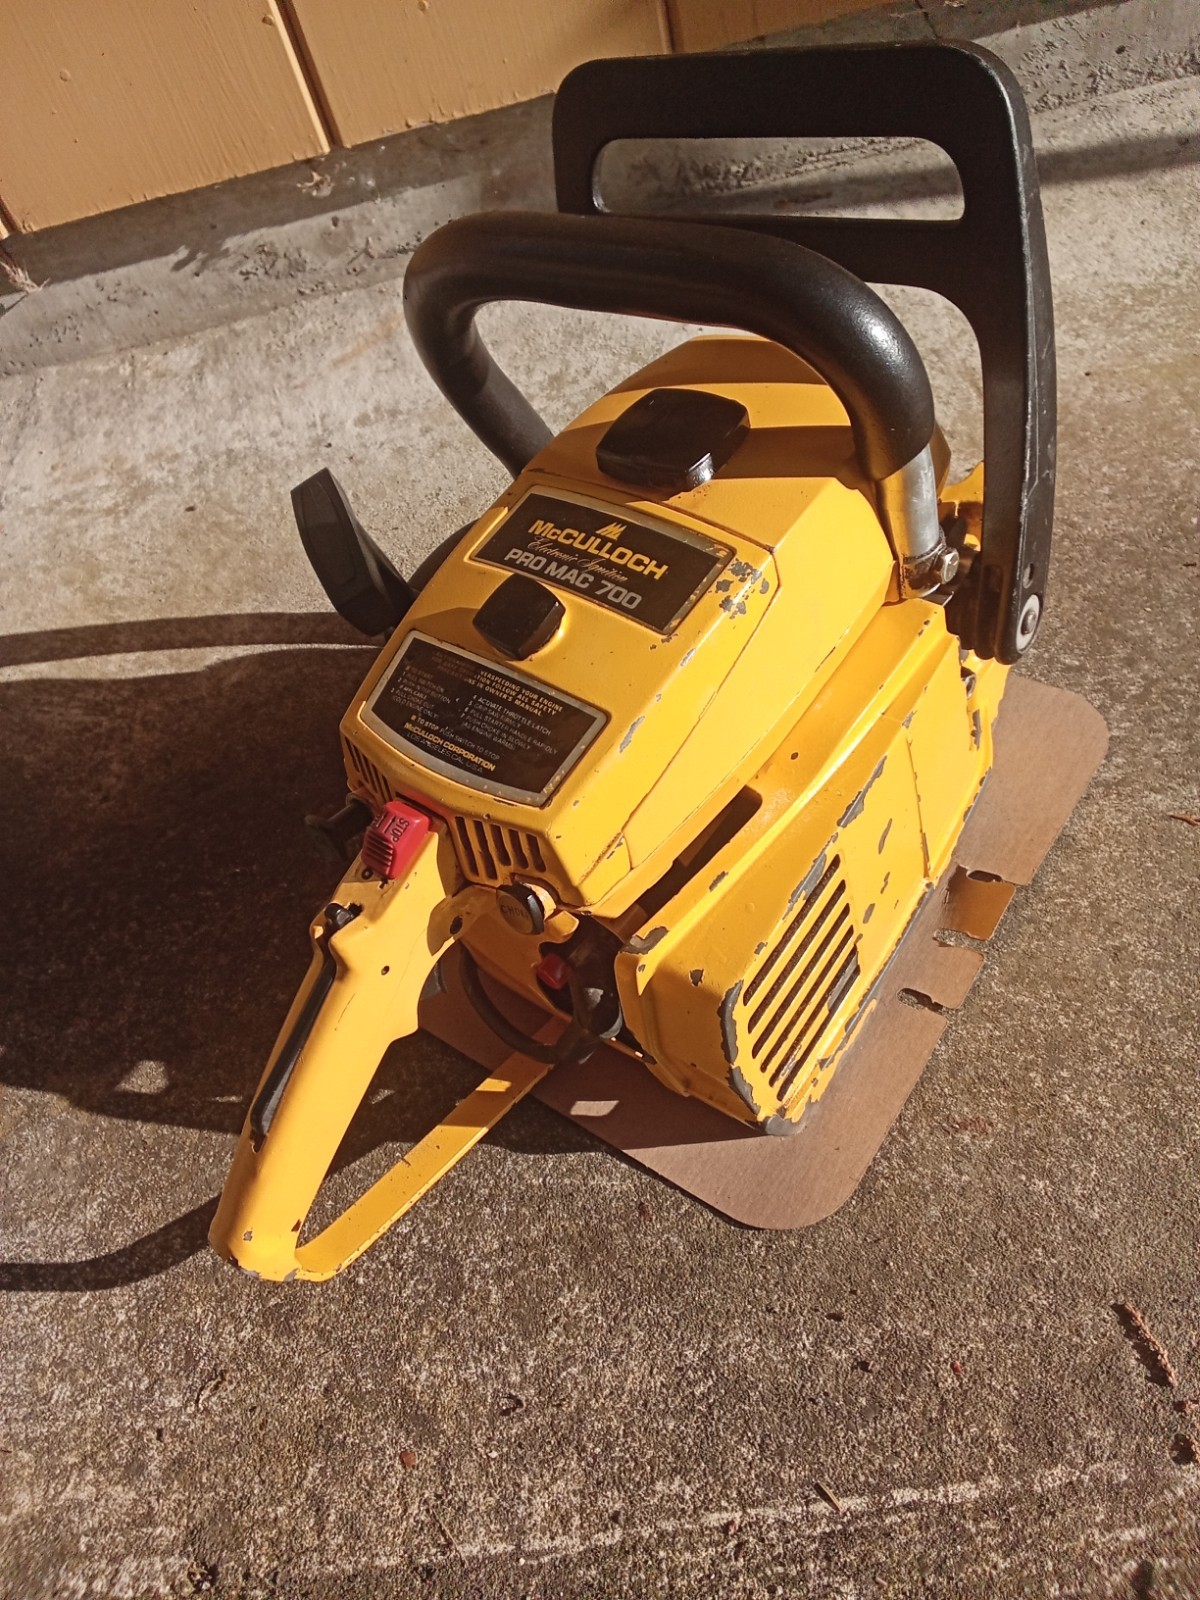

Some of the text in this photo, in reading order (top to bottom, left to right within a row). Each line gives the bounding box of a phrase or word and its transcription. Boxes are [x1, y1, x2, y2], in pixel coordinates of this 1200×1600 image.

[528, 520, 669, 579] McCULLOCH
[528, 537, 628, 582] Electronic Ignition
[504, 548, 642, 609] PRO MAC 700
[484, 685, 514, 702] OWNER'S
[492, 682, 517, 696] FOLLOW
[517, 693, 530, 703] ALL
[530, 700, 558, 716] SAFETY
[521, 689, 539, 700] YOUR
[538, 697, 564, 712] ENGINE
[424, 720, 439, 732] STOP
[477, 696, 502, 711] ACTIVATE
[502, 708, 532, 726] THROTTLE
[530, 722, 553, 736] LATCH
[404, 721, 496, 772] McCULLOCH CORPORATION
[390, 817, 410, 843] STOP
